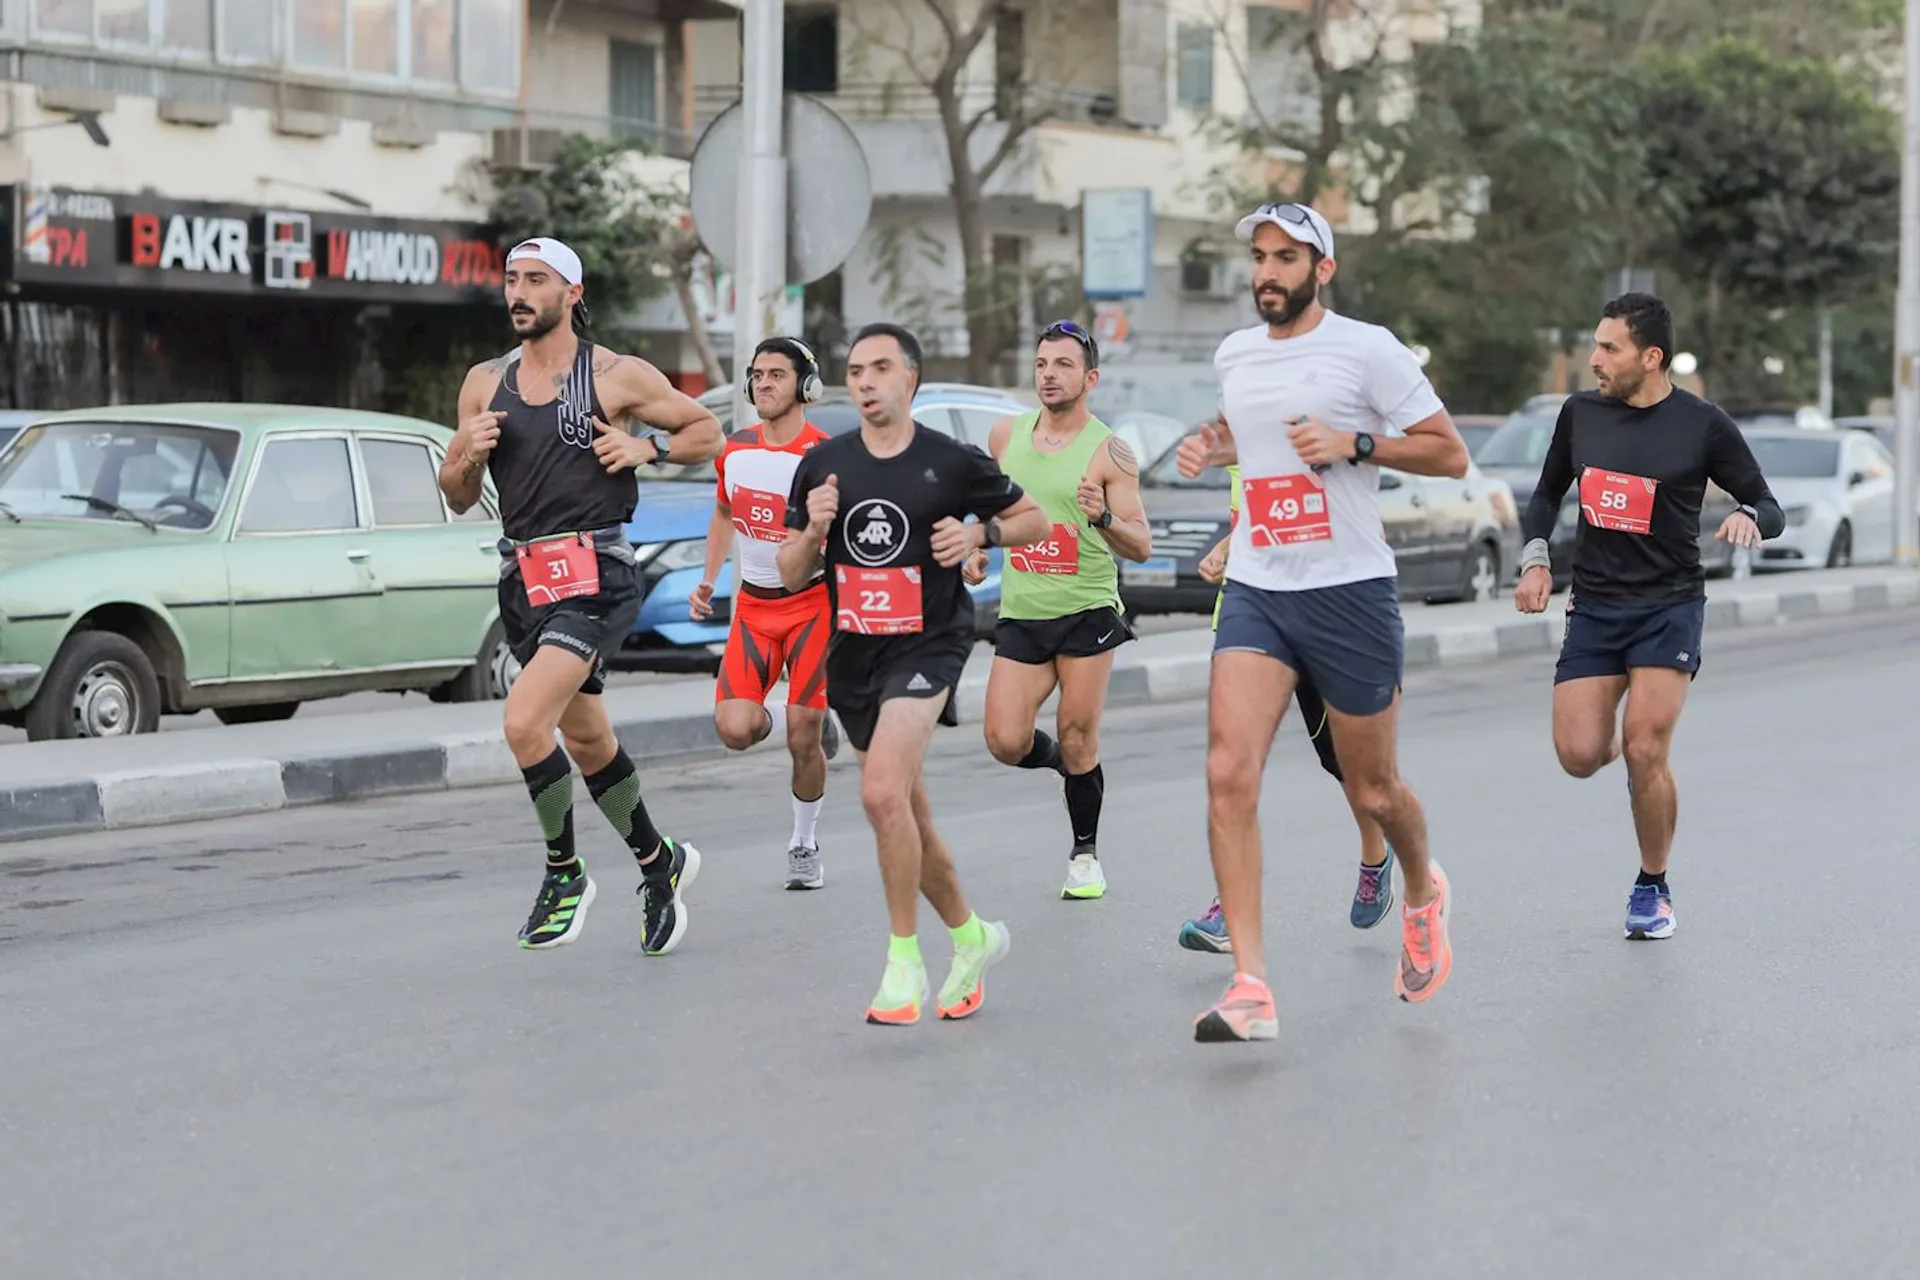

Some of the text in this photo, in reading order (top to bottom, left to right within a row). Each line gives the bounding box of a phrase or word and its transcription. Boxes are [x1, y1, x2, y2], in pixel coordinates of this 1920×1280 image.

[132, 213, 251, 275] BAKR
[1268, 498, 1299, 521] 49
[1600, 490, 1628, 511] 58
[750, 505, 774, 524] 59
[547, 558, 570, 579] 31
[860, 590, 891, 612] 22
